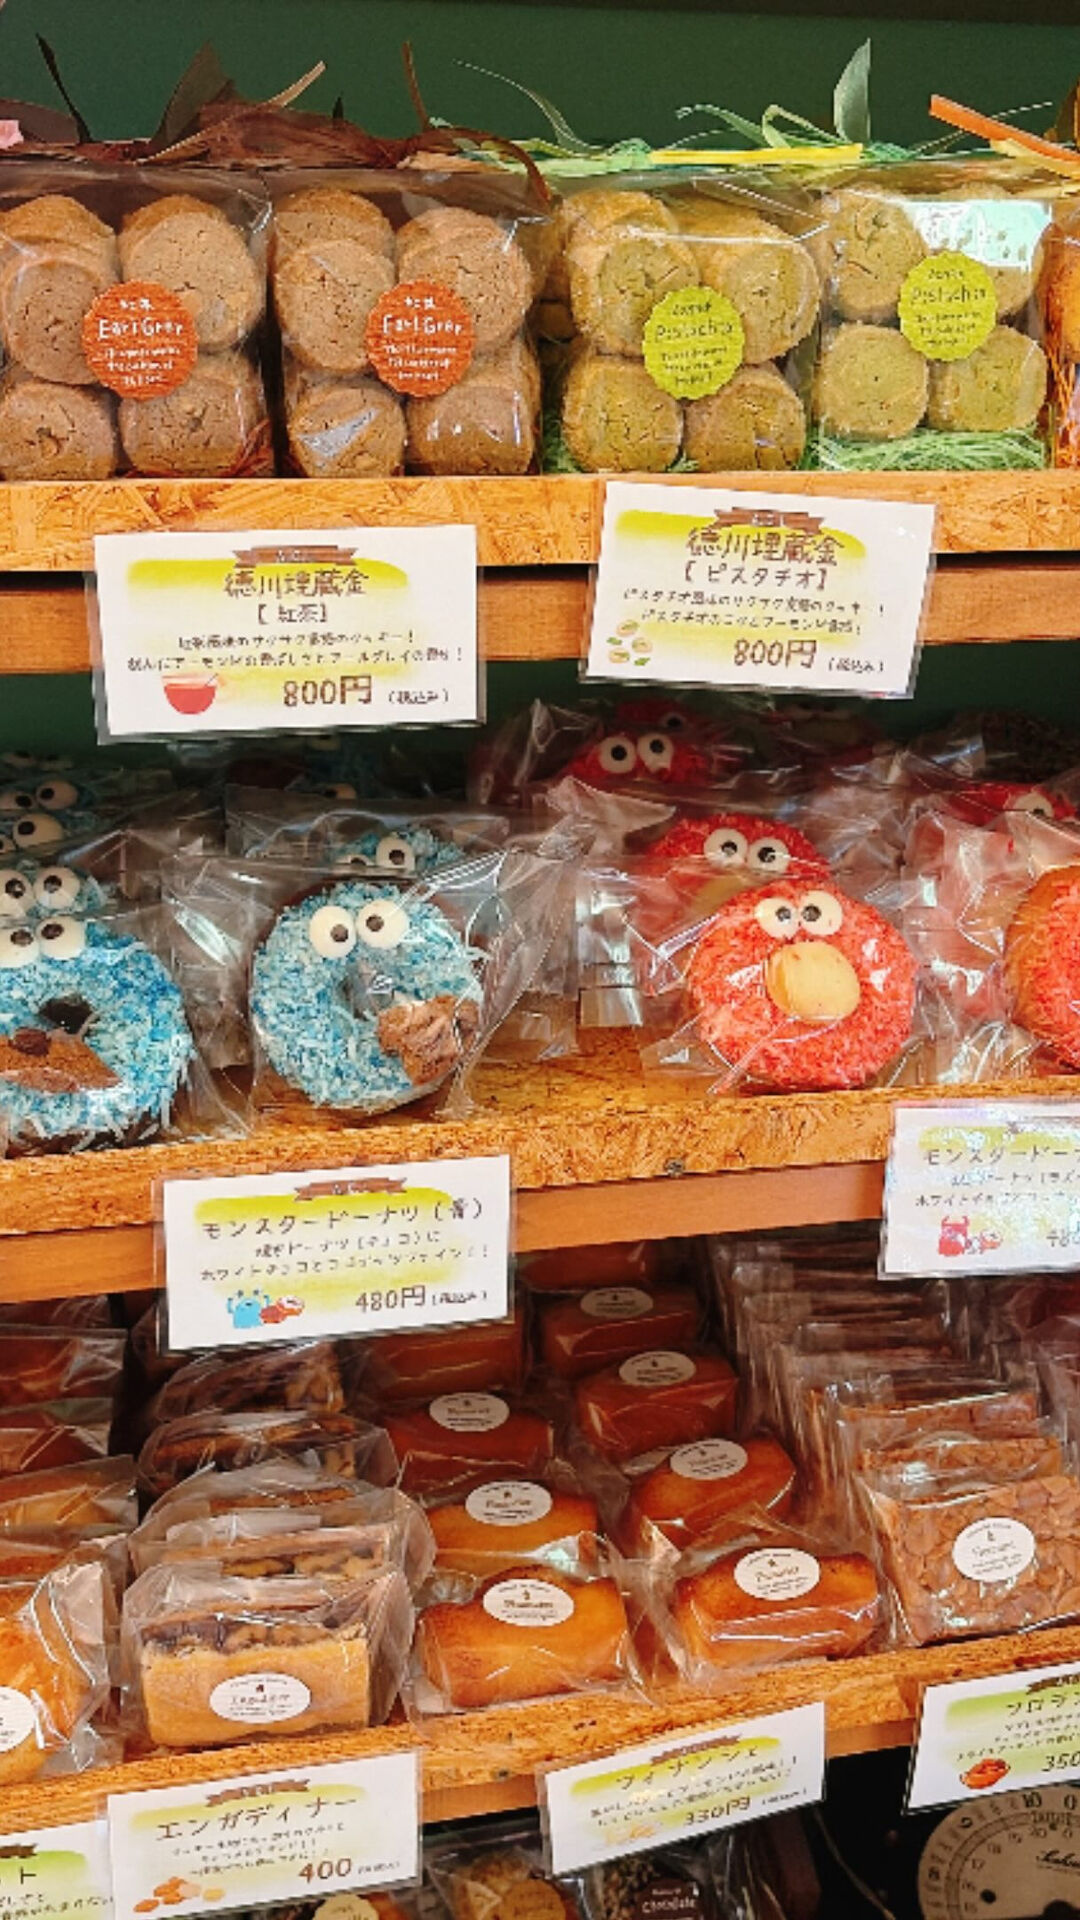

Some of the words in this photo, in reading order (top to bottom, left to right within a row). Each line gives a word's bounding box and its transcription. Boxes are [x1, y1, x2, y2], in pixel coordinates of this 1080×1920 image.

[684, 526, 846, 567] 徳川埋蔵金
[224, 567, 370, 600] 徳川埋蔵金
[733, 638, 818, 670] 800円
[282, 674, 373, 708] 800円
[354, 1284, 427, 1314] 480円
[615, 1744, 759, 1792] フィナンシェ
[156, 1795, 358, 1842] エンガディナー
[683, 1794, 751, 1827] 330円
[298, 1857, 353, 1883] 400
